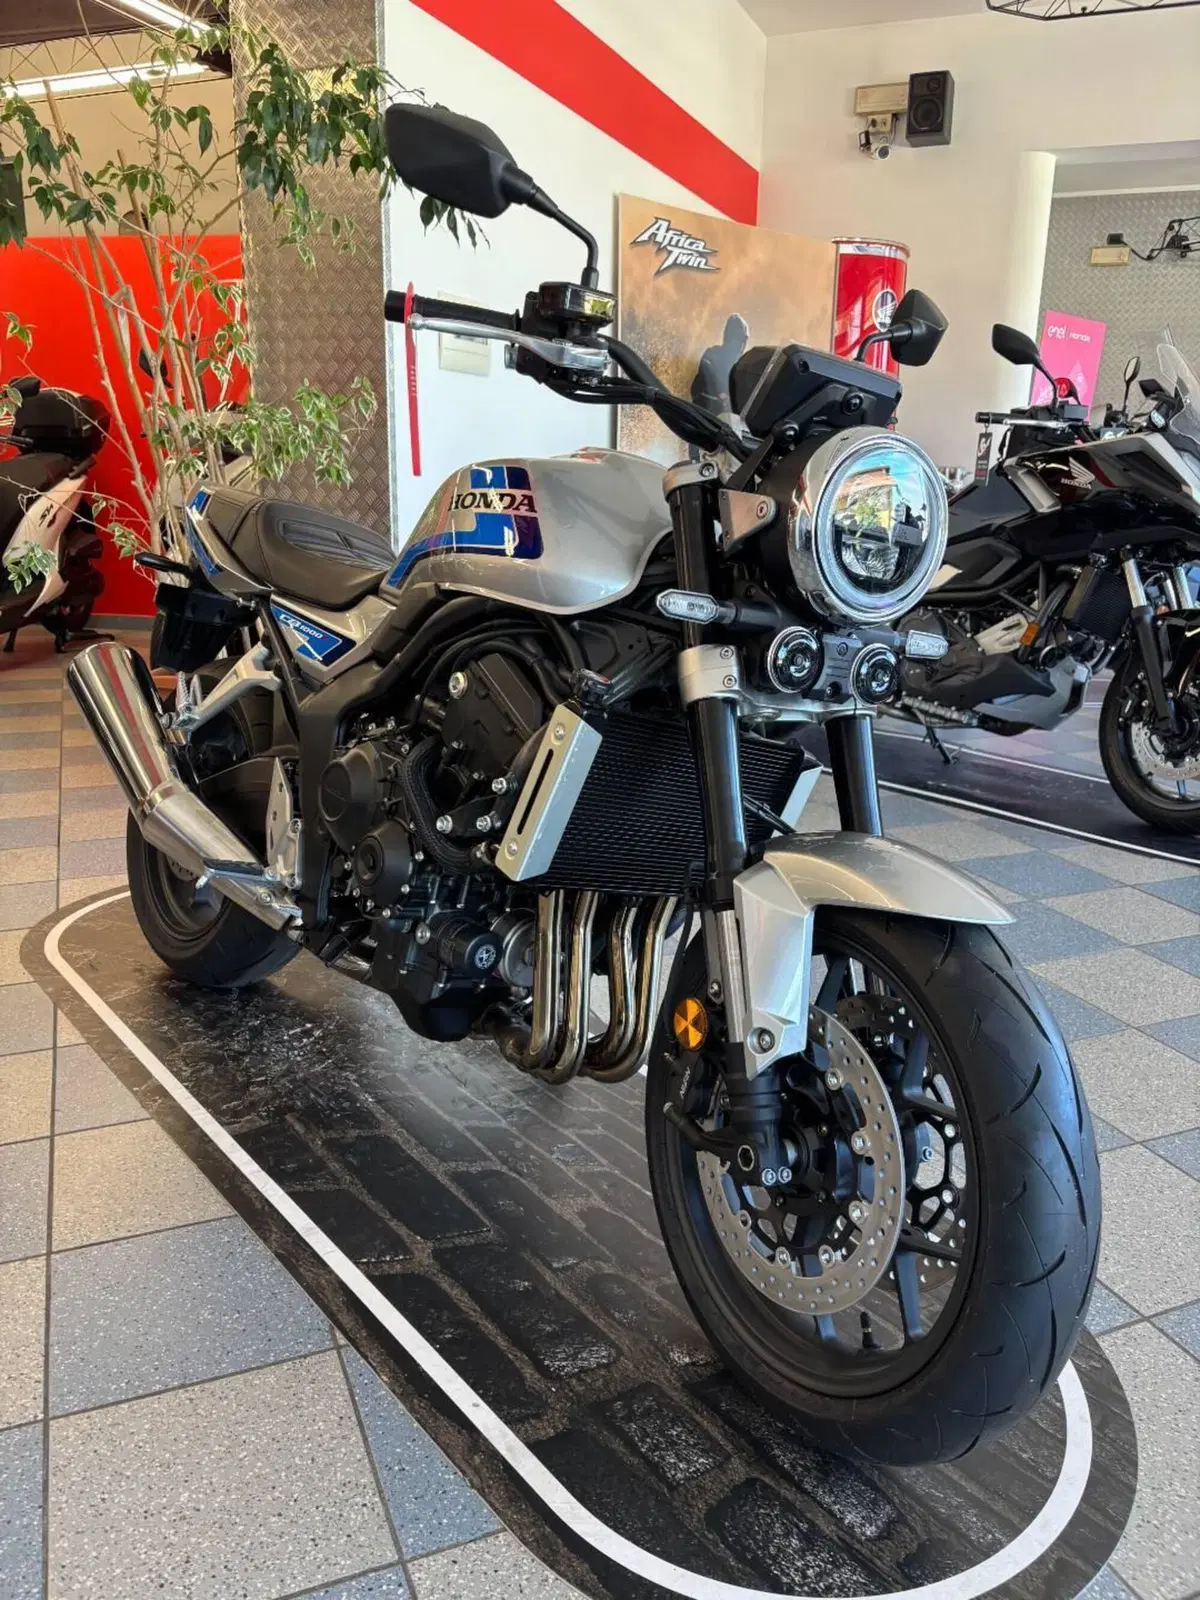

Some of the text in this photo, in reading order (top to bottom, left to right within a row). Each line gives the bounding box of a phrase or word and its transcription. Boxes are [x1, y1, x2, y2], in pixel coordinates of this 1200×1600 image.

[631, 217, 717, 253] Africa
[656, 245, 721, 274] Twin
[1060, 477, 1092, 489] HONDA
[448, 492, 537, 513] HONDA
